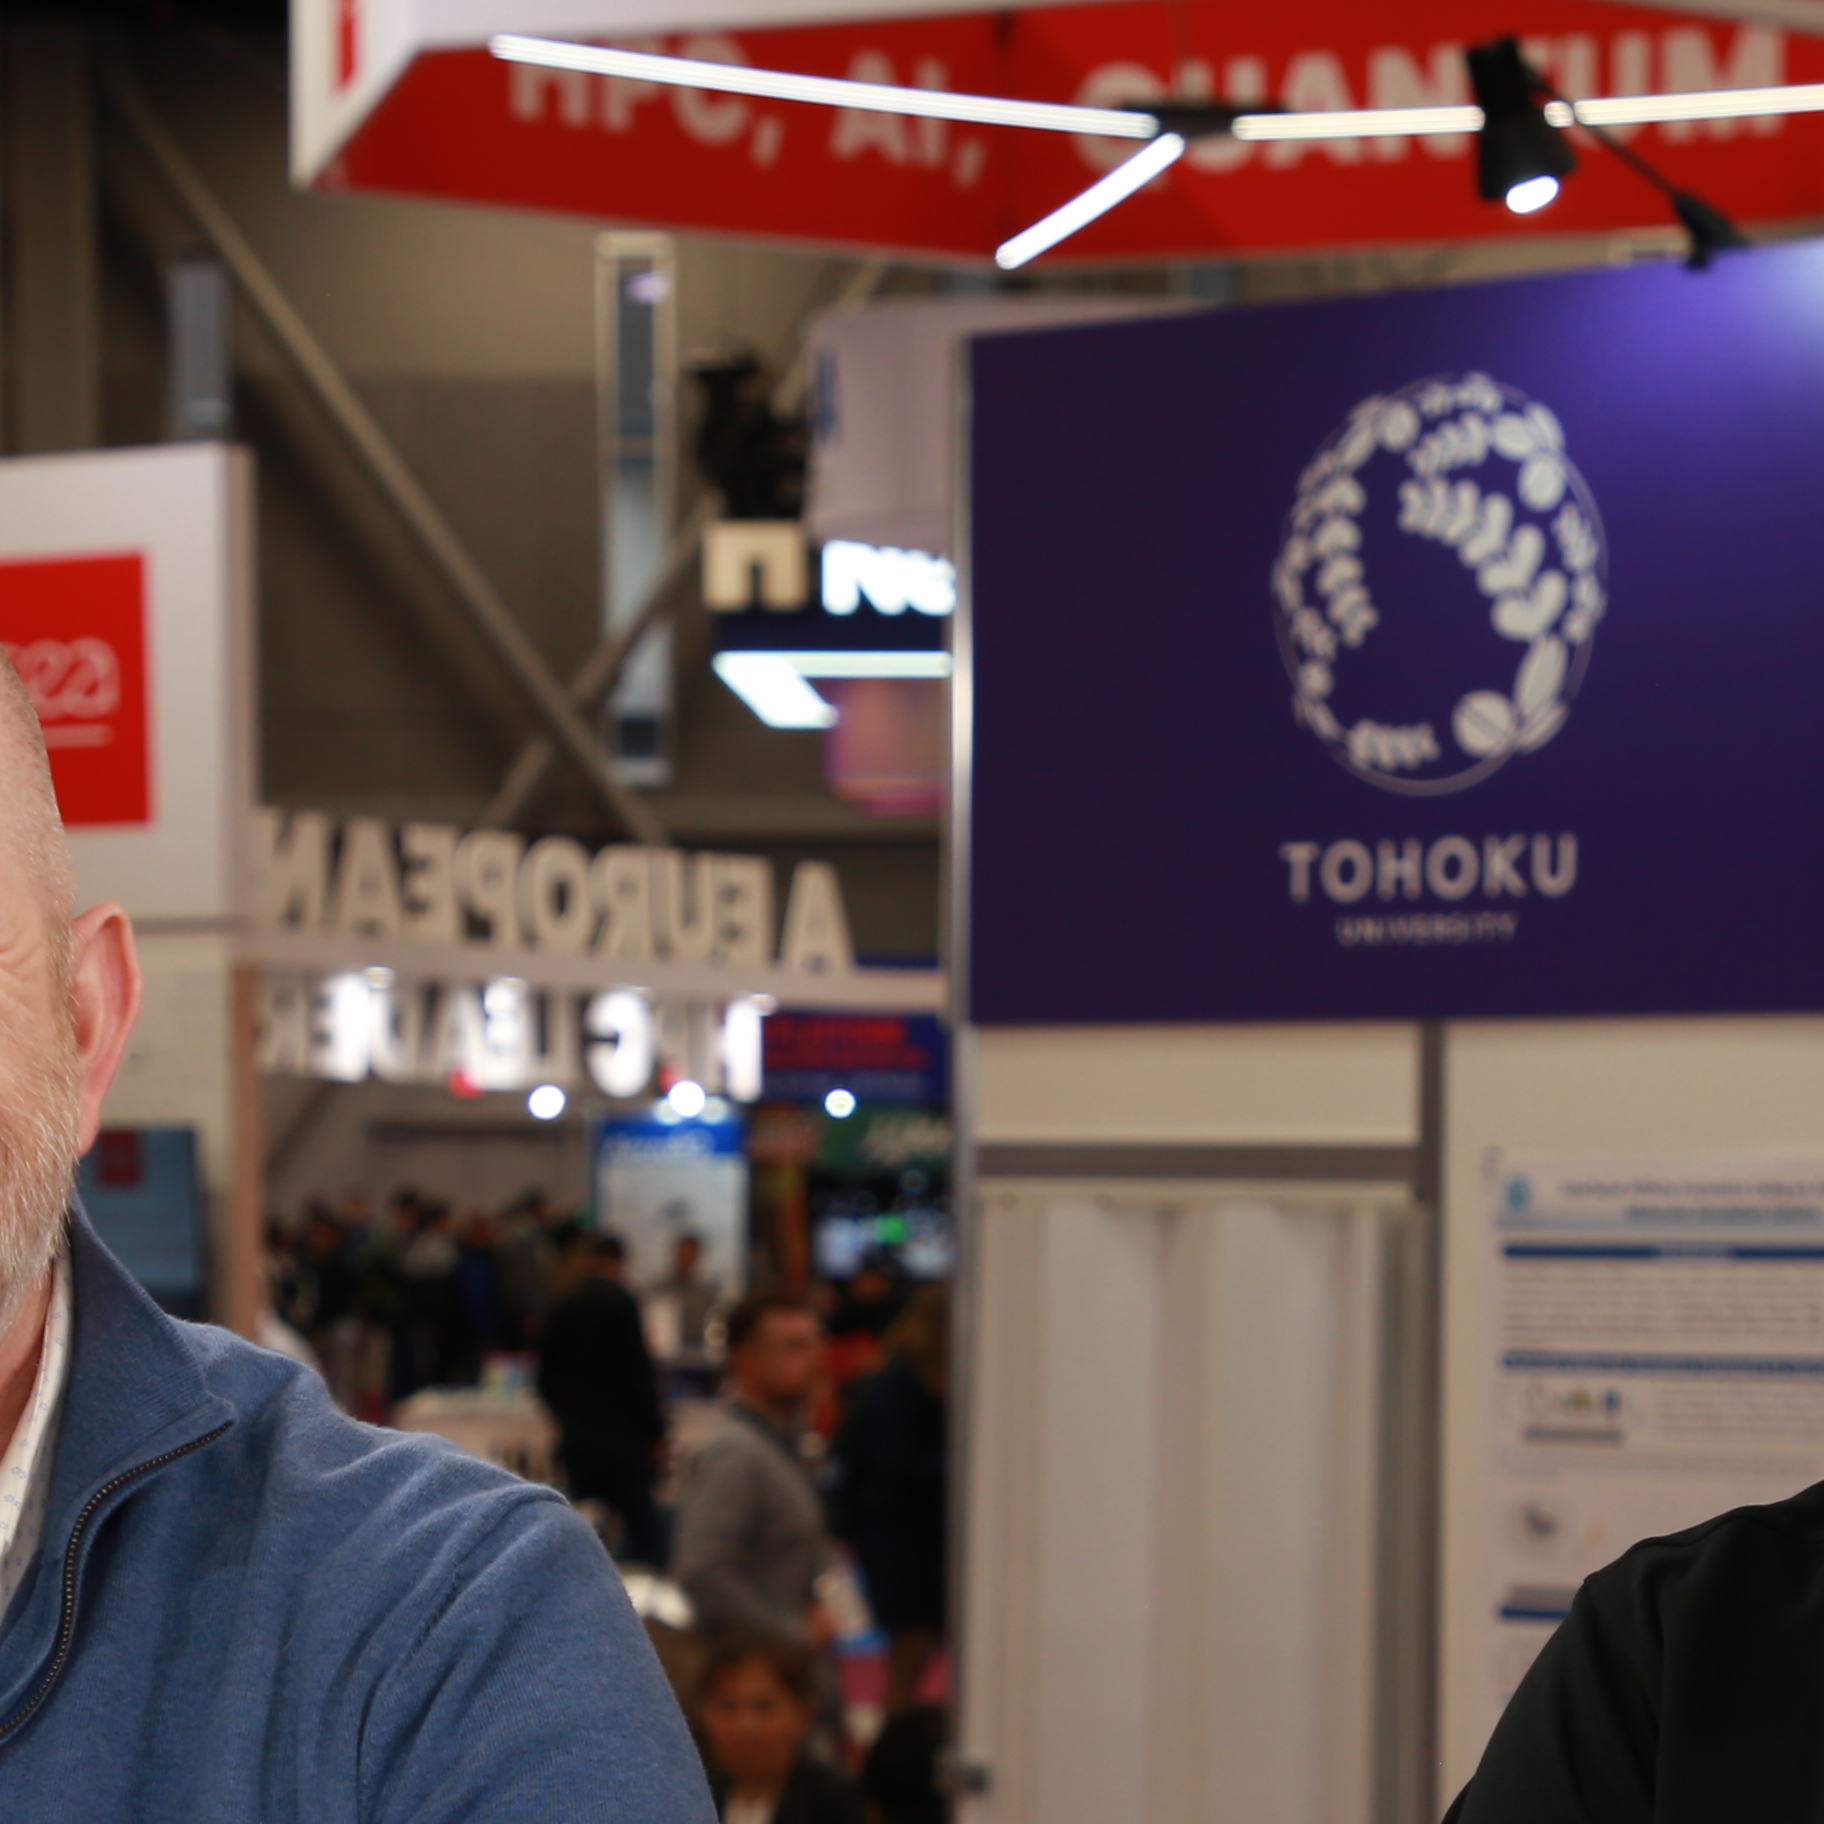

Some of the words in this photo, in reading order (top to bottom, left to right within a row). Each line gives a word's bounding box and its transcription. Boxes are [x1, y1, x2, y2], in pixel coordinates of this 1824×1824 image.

[1072, 18, 1788, 192] QUANUM
[1279, 832, 1578, 904] TOHOKU
[1336, 911, 1519, 946] UNIVERSITY
